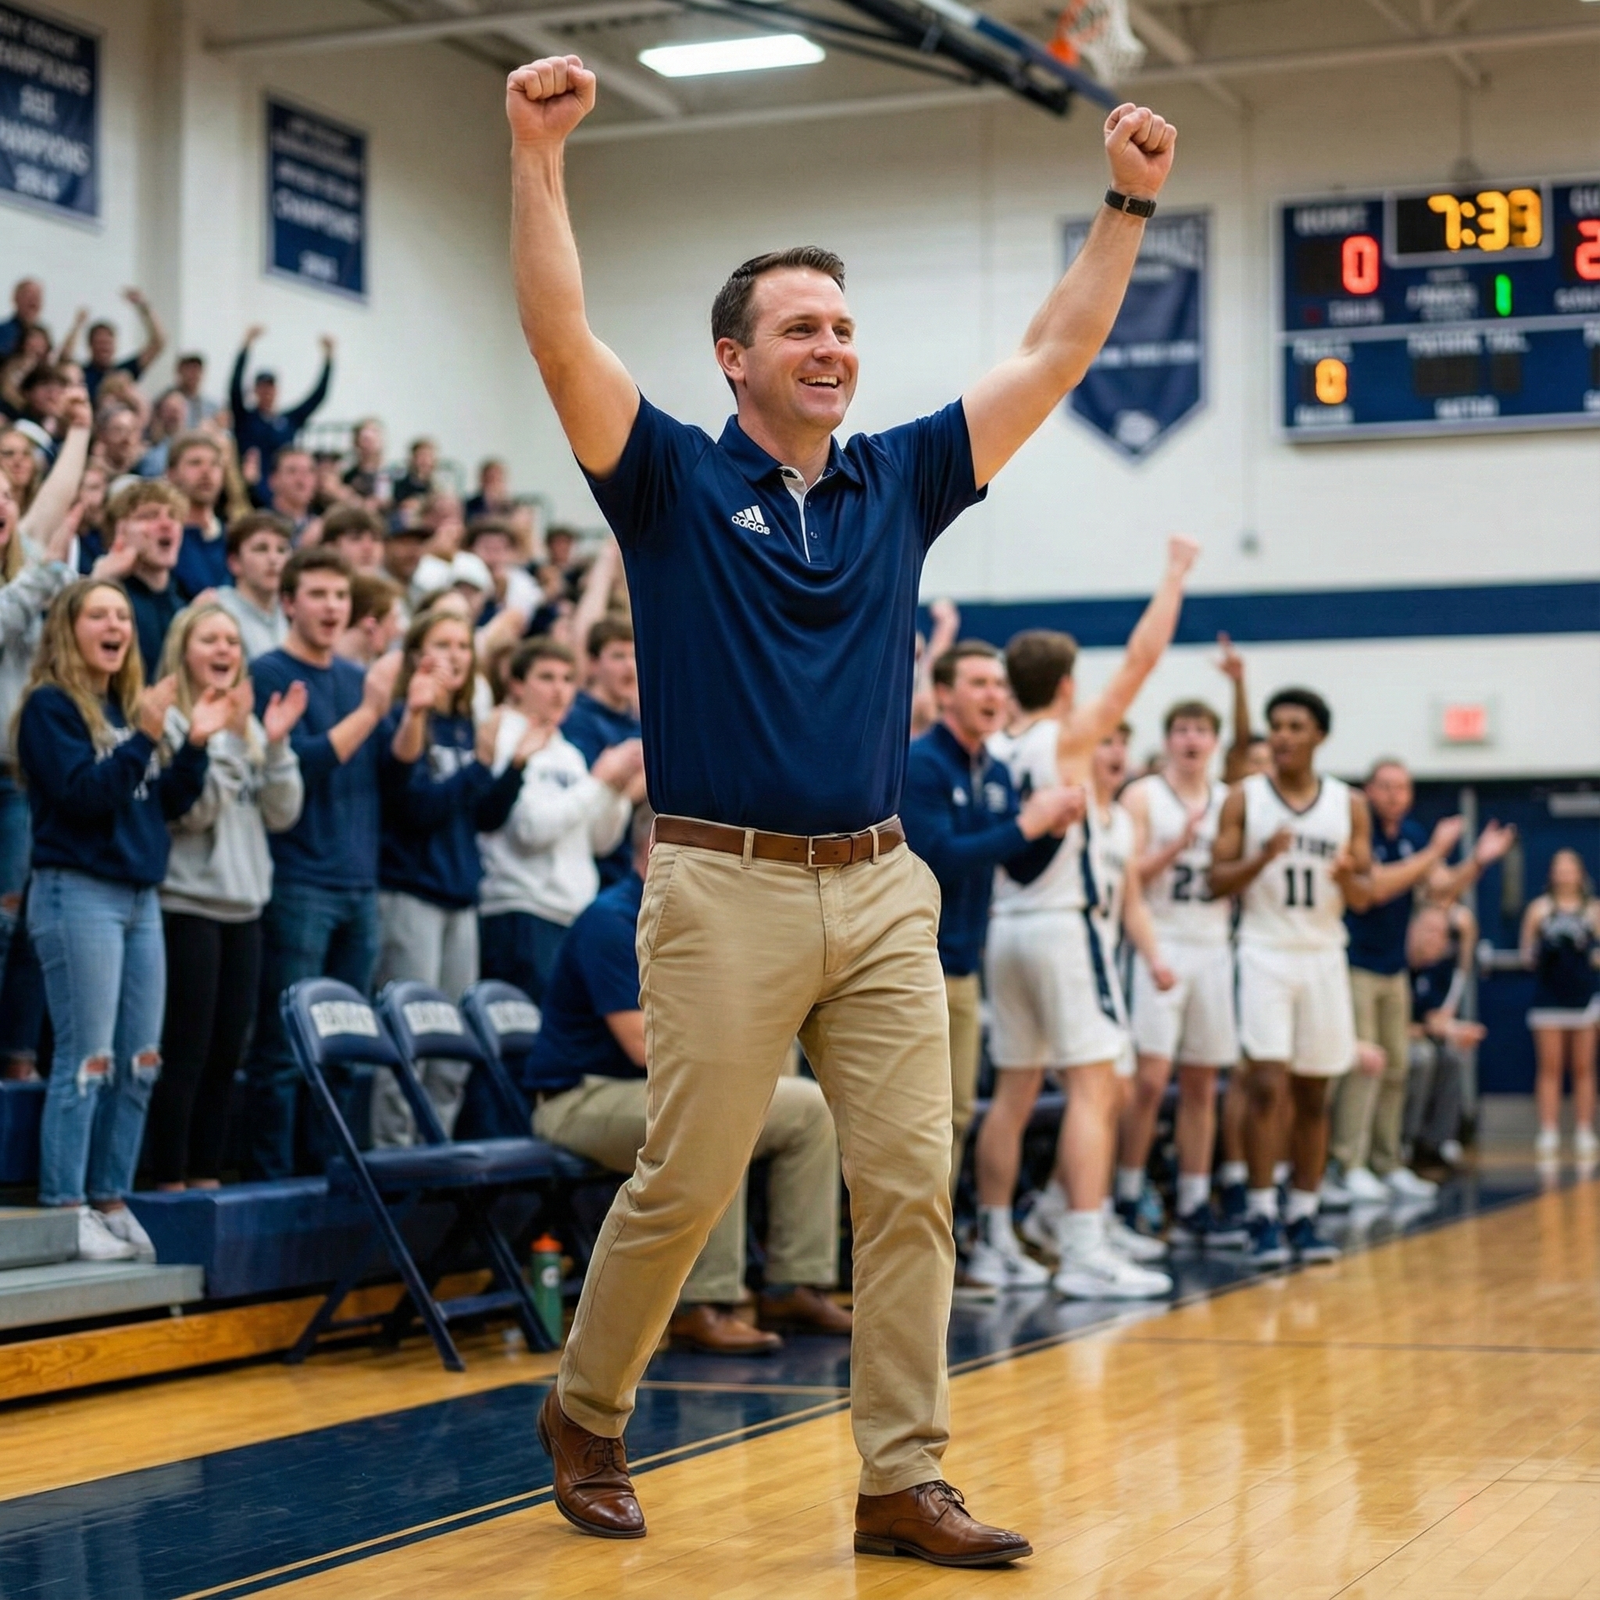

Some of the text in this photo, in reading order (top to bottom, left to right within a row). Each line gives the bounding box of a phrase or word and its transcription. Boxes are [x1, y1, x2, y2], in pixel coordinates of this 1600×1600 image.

[1342, 235, 1379, 294] 0
[1495, 273, 1512, 317] 1
[731, 515, 771, 535] adidas
[1285, 867, 1315, 908] 11
